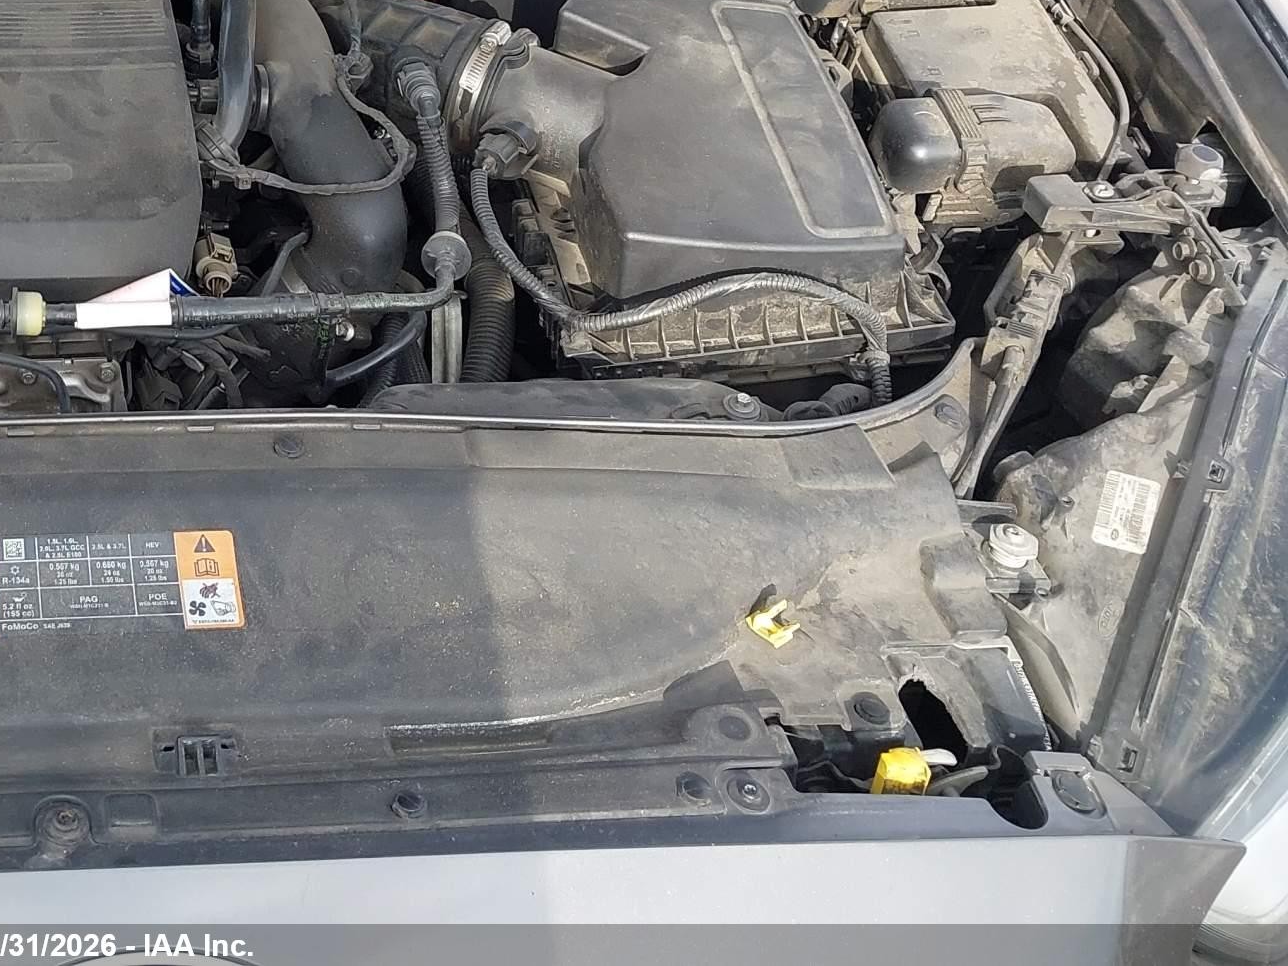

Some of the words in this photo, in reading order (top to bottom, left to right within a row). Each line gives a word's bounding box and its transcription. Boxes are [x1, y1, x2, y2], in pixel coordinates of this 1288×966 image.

[116, 561, 126, 570] kg
[159, 559, 169, 568] kg
[2, 577, 30, 585] R-134a
[79, 595, 99, 603] PAG
[148, 593, 168, 601] POE
[3, 610, 21, 618] (155
[22, 609, 35, 617] cc)
[1, 622, 39, 631] FoMoCo
